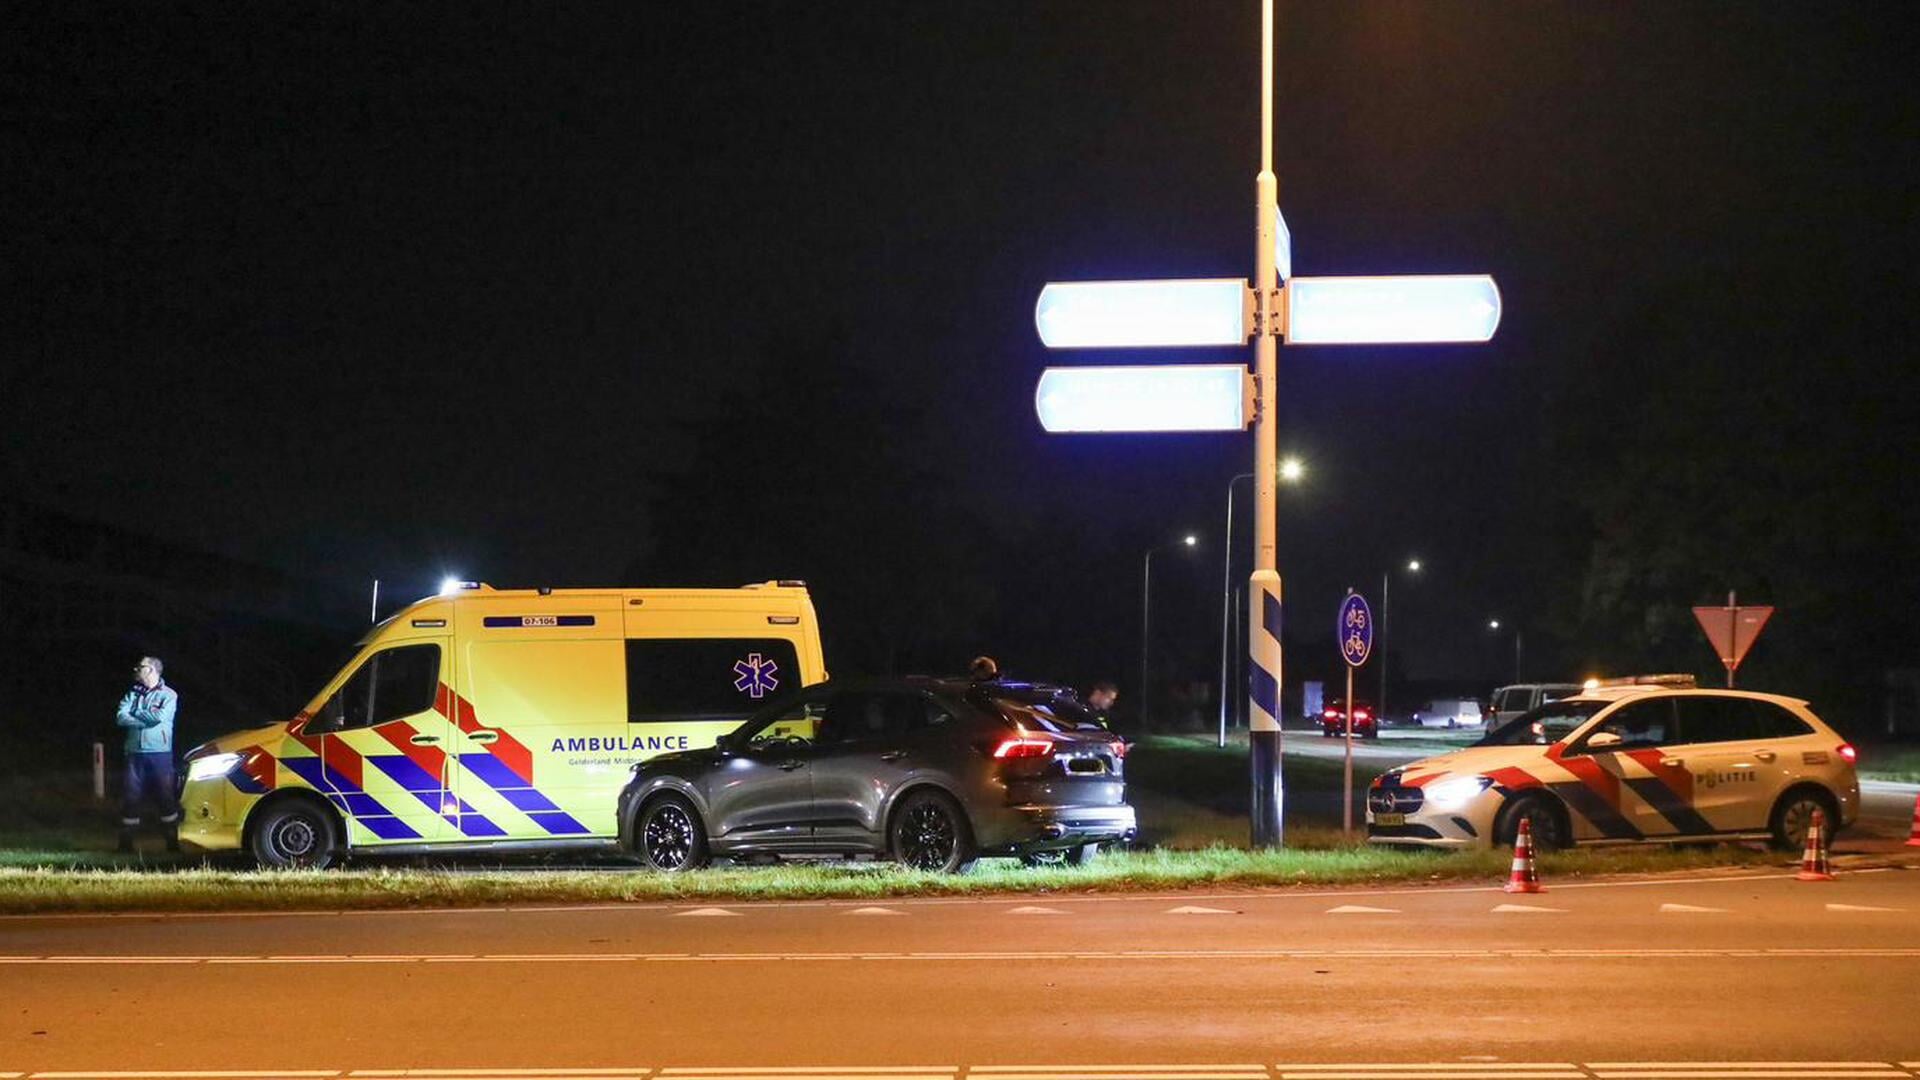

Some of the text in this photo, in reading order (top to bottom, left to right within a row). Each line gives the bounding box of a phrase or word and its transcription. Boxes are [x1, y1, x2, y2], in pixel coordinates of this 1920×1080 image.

[524, 617, 556, 625] 07-106
[551, 736, 689, 752] AMBULANCE
[568, 758, 611, 766] Gelderland
